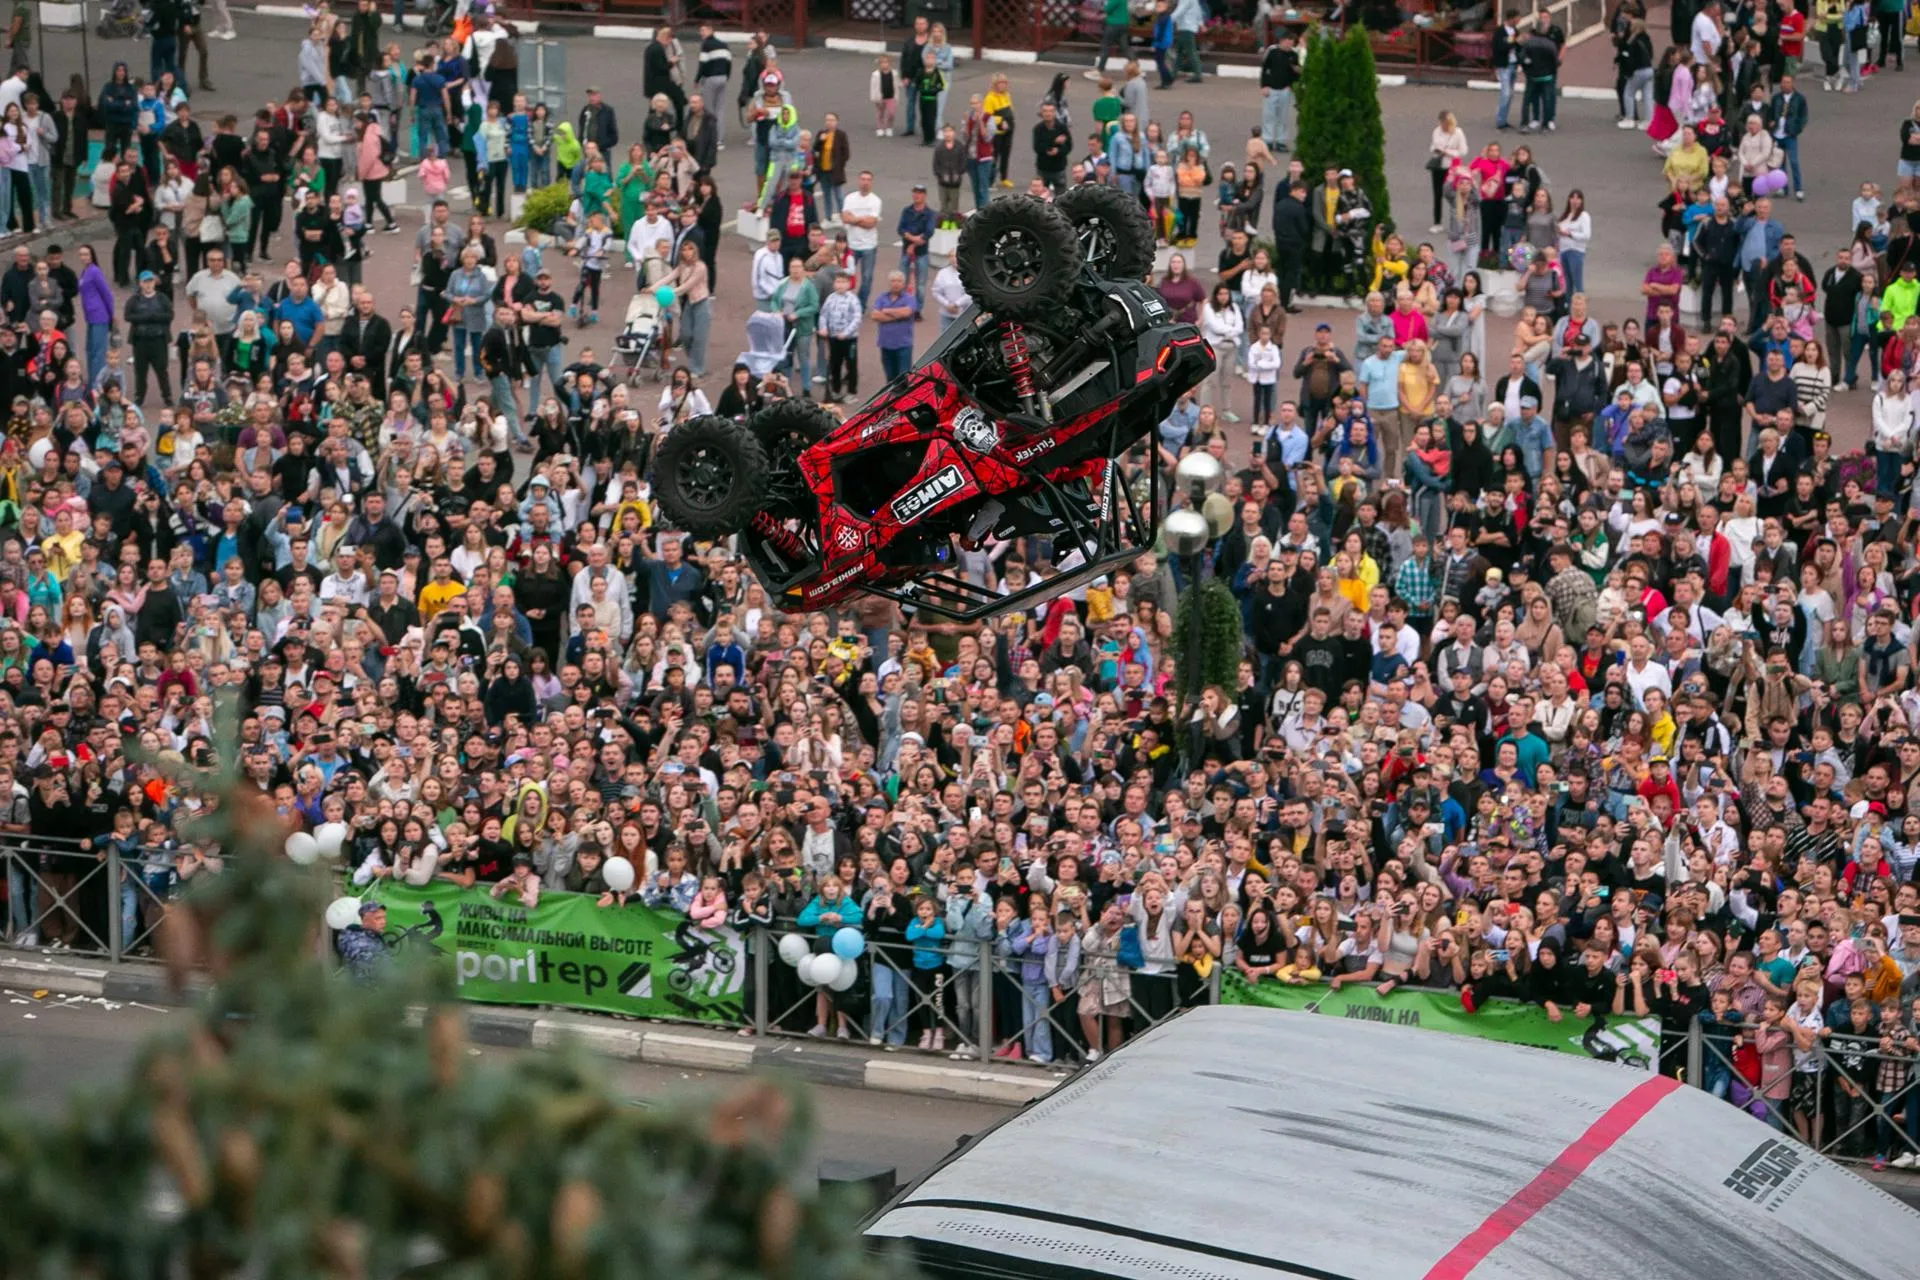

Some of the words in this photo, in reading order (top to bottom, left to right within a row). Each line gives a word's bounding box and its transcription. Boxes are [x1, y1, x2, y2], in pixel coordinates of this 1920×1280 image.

[895, 467, 957, 520] AIMOL
[457, 921, 586, 949] МАКСИМАЛЬНОЙ
[590, 934, 653, 957] ВЫСОТЕ
[1345, 1003, 1394, 1024] ЖИВИ
[1397, 1009, 1421, 1027] НА
